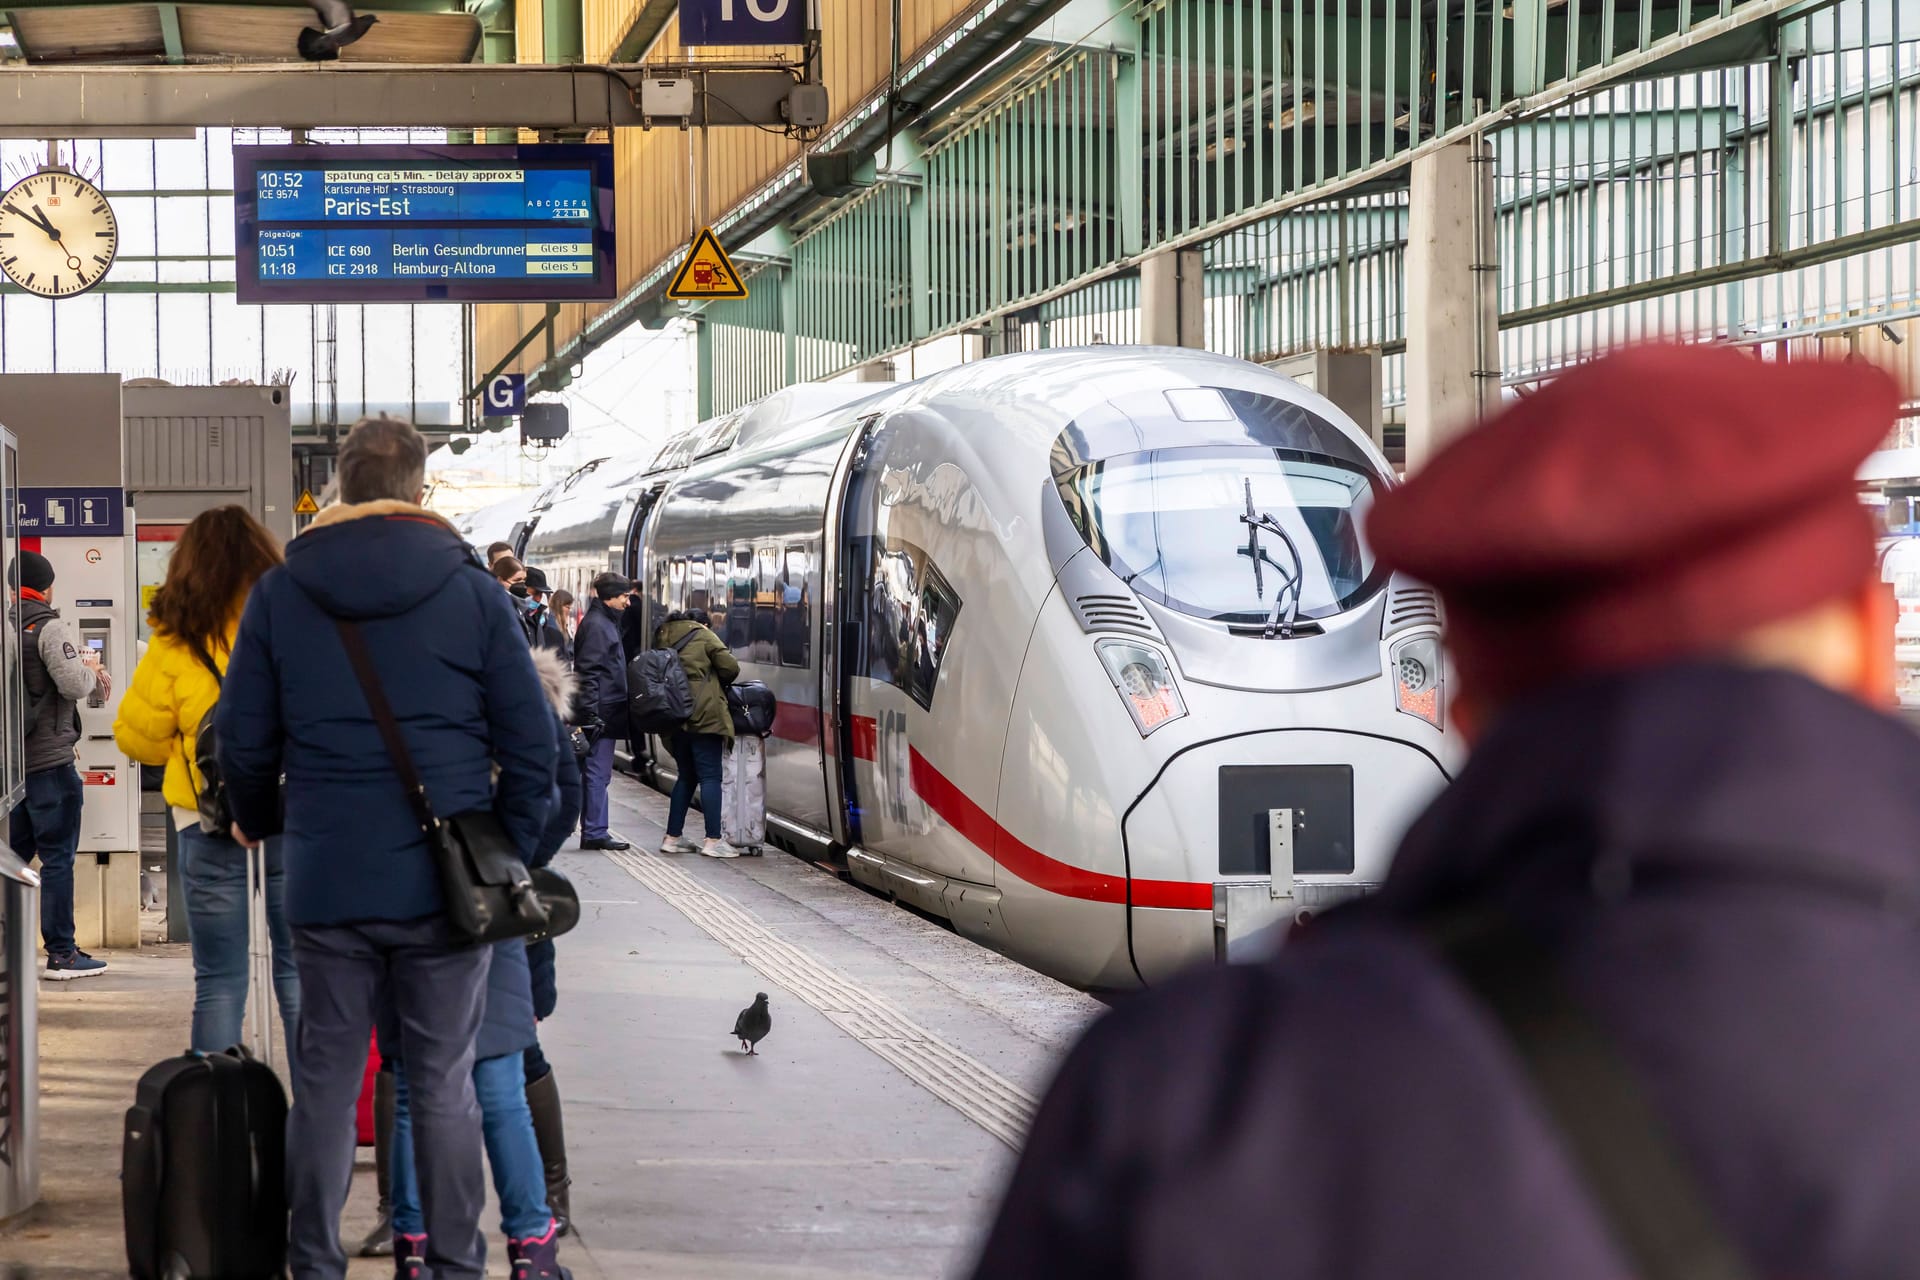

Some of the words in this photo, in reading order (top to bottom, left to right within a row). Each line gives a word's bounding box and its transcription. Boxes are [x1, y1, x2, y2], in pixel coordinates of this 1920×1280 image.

[260, 172, 303, 188] 10:52
[393, 171, 401, 180] 5
[403, 171, 425, 180] Min.
[436, 171, 469, 182] Delay
[472, 173, 513, 182] approx
[515, 171, 522, 180] 5
[259, 190, 273, 199] ICE
[276, 190, 299, 199] 9574
[324, 185, 371, 194] Karlsruhe
[373, 185, 389, 194] Hbf
[402, 185, 455, 196] Strasbourg
[325, 198, 410, 216] Paris-Est
[259, 230, 303, 239] Folgezüge:
[260, 244, 295, 257] 10:51
[328, 245, 346, 257] ICE
[350, 245, 371, 256] 690
[393, 243, 429, 256] Berlin
[541, 243, 568, 252] Gleis
[572, 243, 578, 252] 9
[261, 262, 296, 275] 11:18
[328, 263, 346, 275] ICE
[350, 263, 378, 275] 2918
[393, 261, 496, 277] Hamburg-Altona
[541, 262, 568, 271] Gleis
[572, 262, 578, 271] 5
[488, 374, 514, 408] G
[879, 709, 908, 825] ICE
